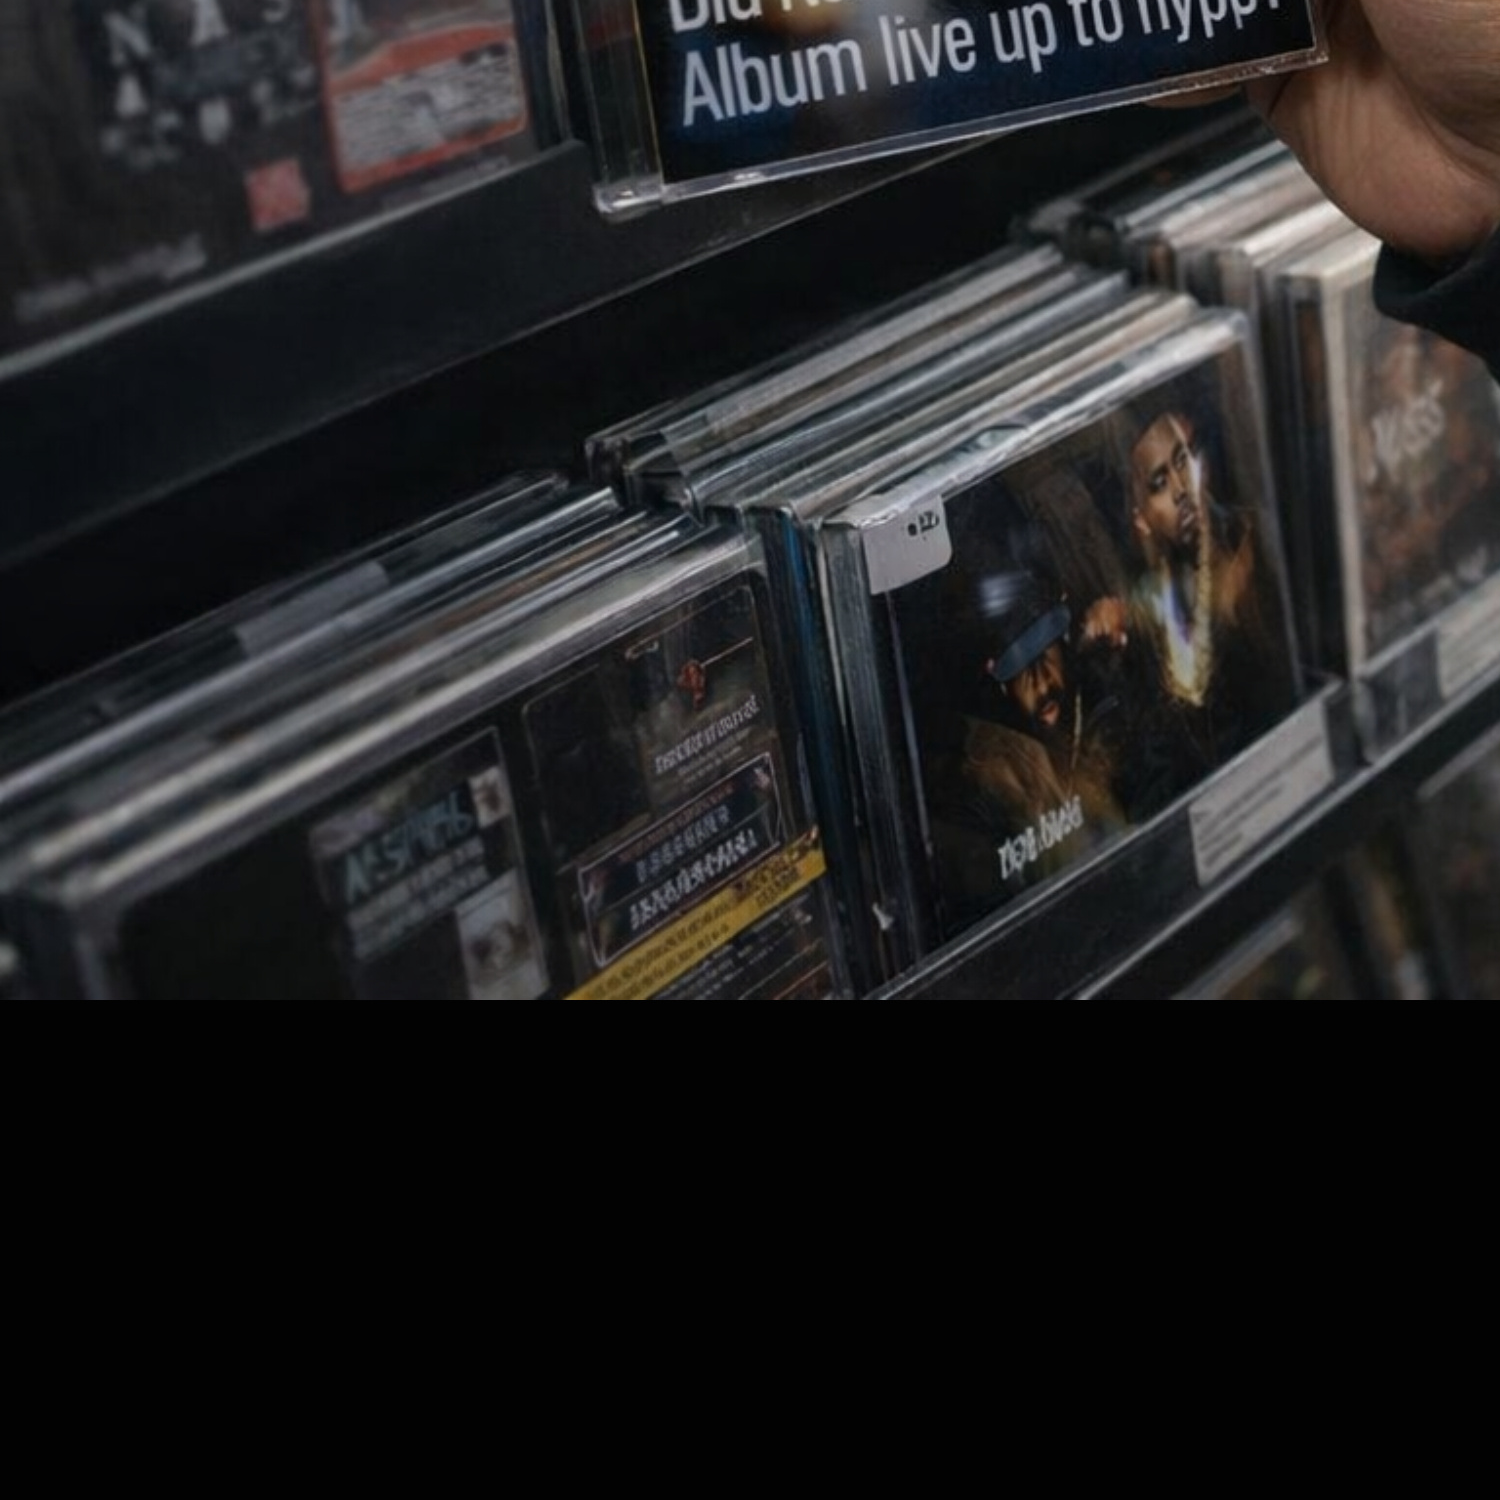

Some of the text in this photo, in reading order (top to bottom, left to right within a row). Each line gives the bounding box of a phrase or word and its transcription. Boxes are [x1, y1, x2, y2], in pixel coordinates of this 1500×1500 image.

[682, 35, 867, 127] Album
[879, 14, 975, 86] live
[989, 2, 1057, 75] up
